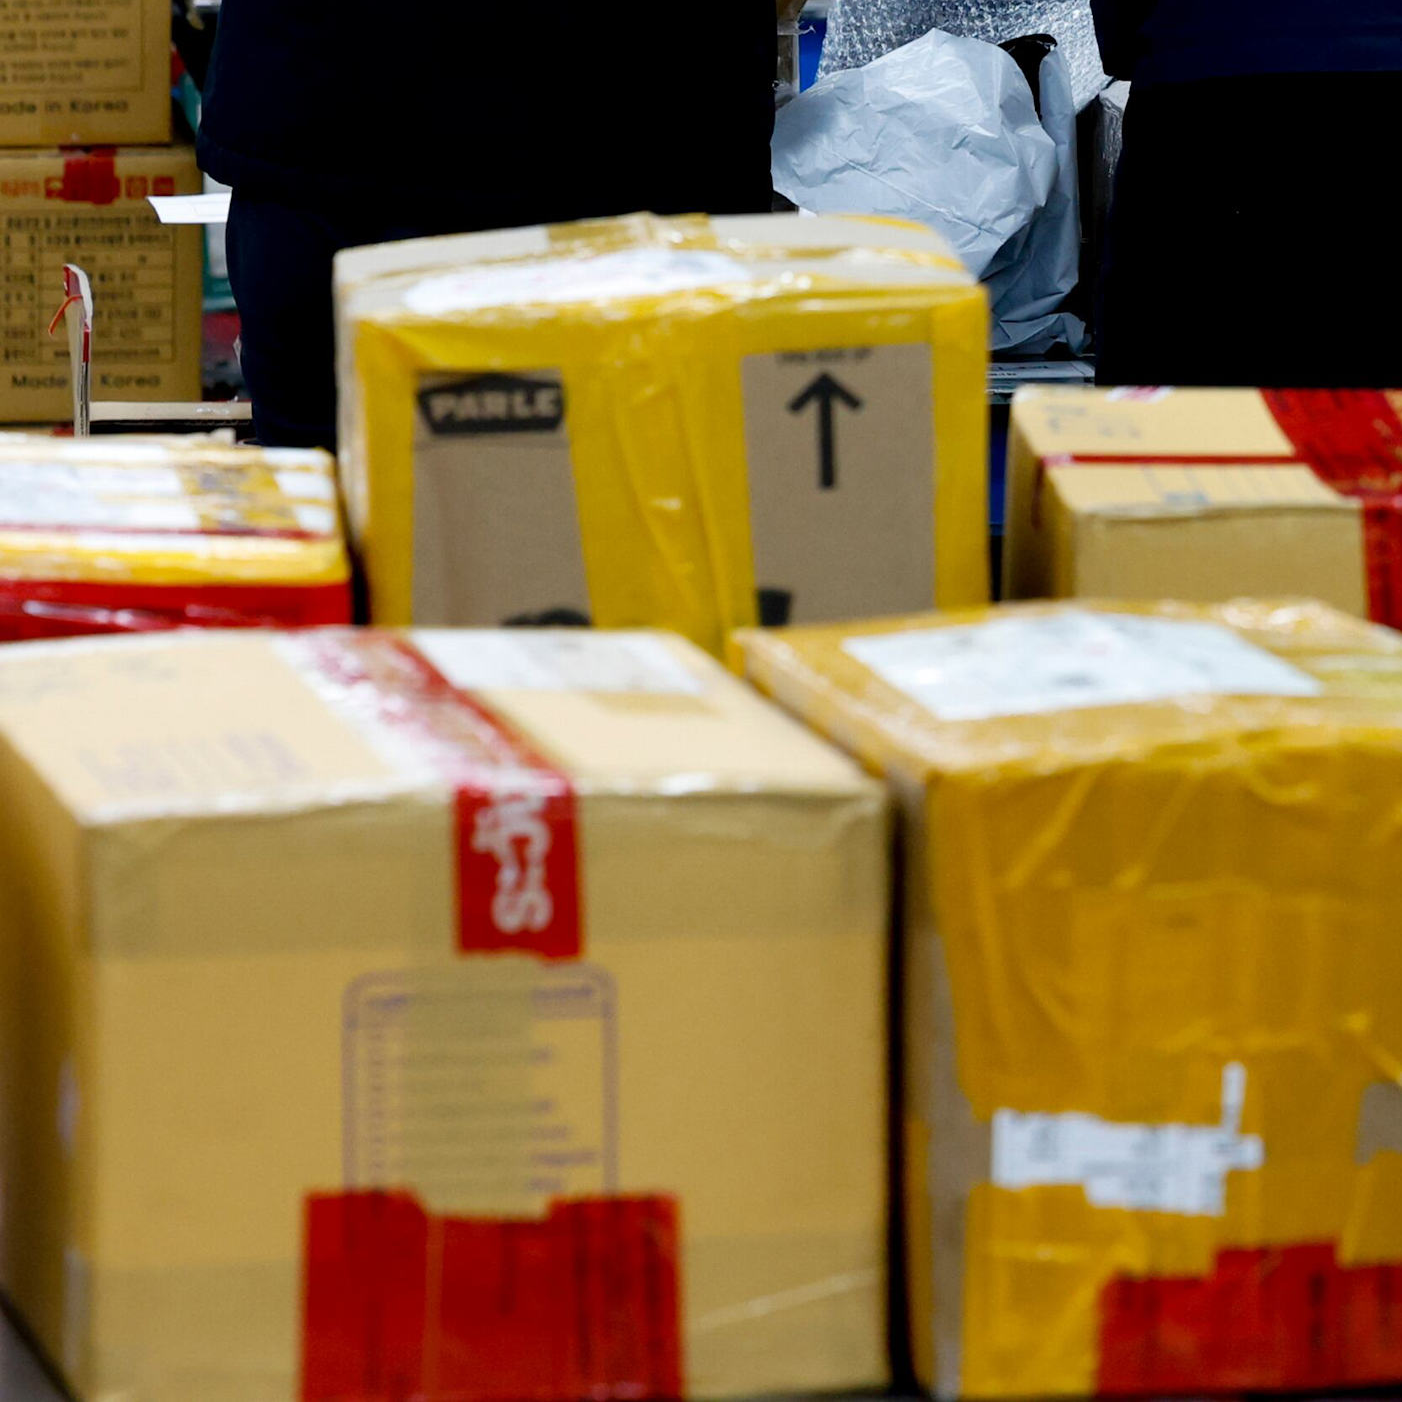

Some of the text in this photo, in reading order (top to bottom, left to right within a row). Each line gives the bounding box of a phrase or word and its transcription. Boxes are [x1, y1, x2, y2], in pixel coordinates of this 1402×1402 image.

[0, 101, 37, 114] ade
[12, 373, 161, 388] Made Korea
